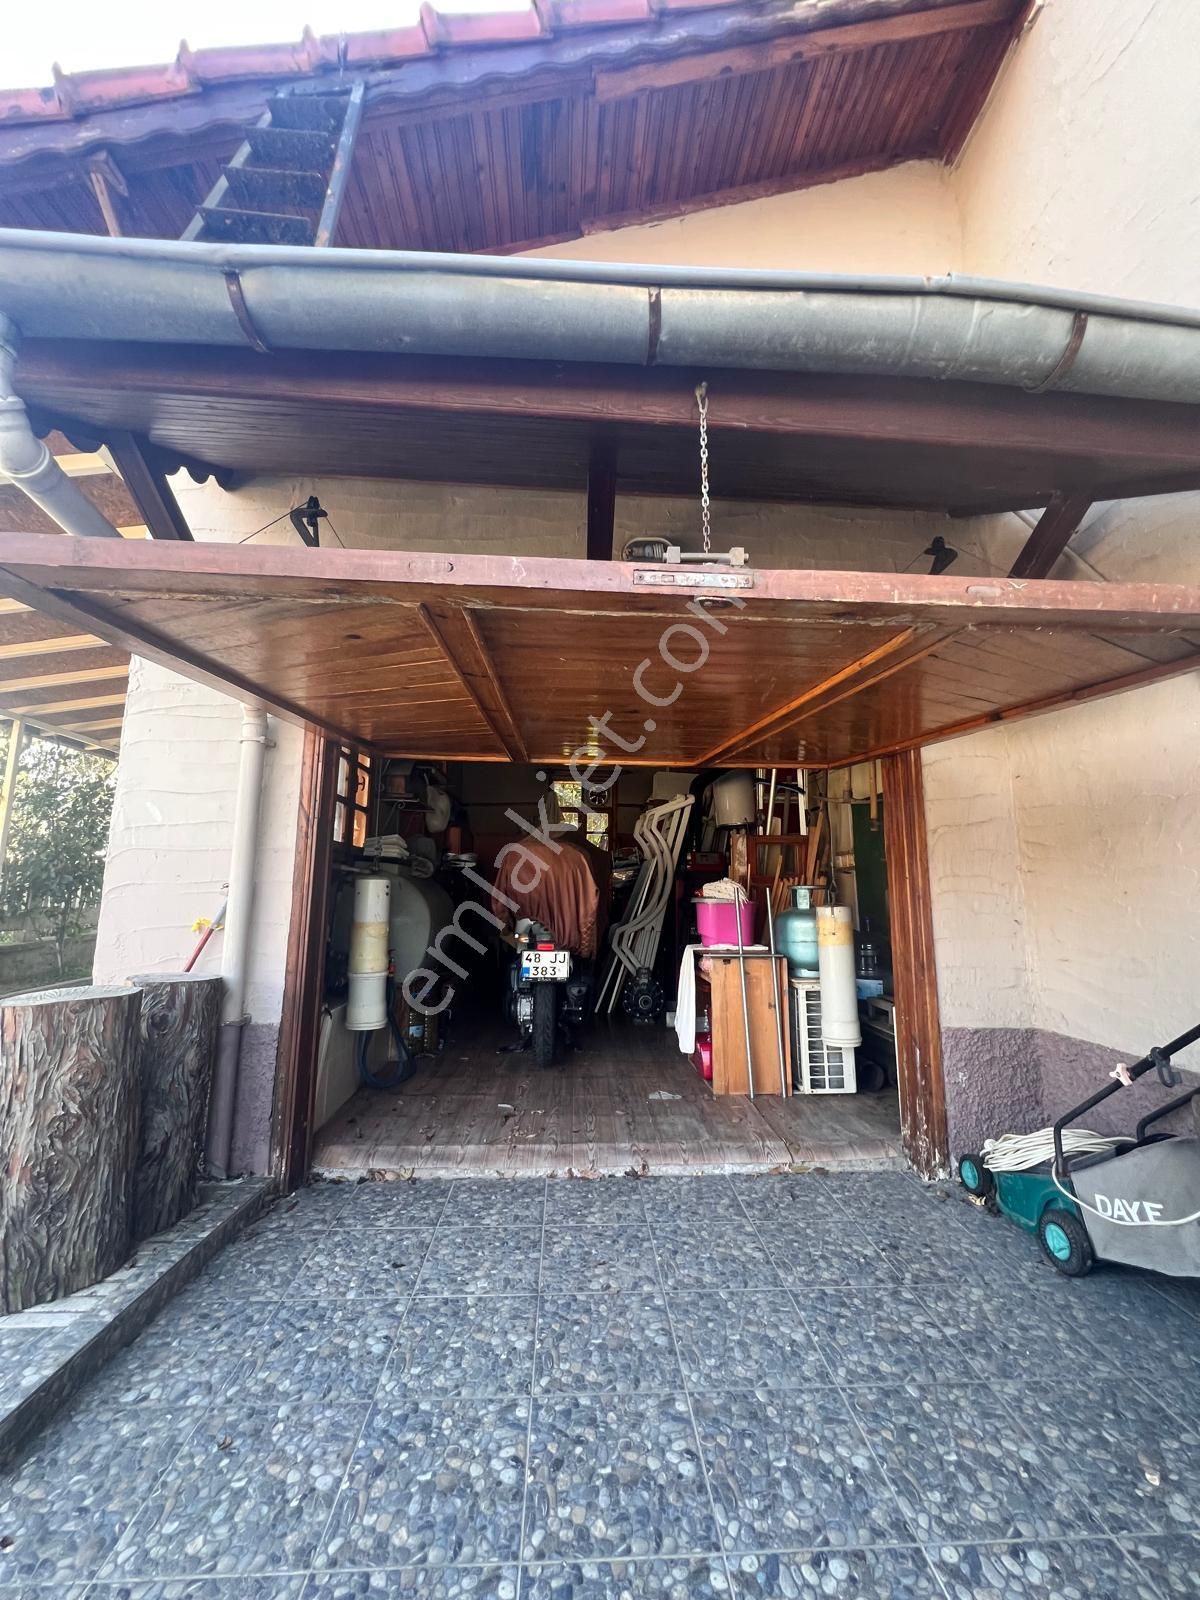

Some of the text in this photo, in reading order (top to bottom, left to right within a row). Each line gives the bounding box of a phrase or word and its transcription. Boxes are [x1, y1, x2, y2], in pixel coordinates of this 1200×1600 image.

[525, 953, 566, 964] 48 JJ
[532, 966, 557, 976] 383
